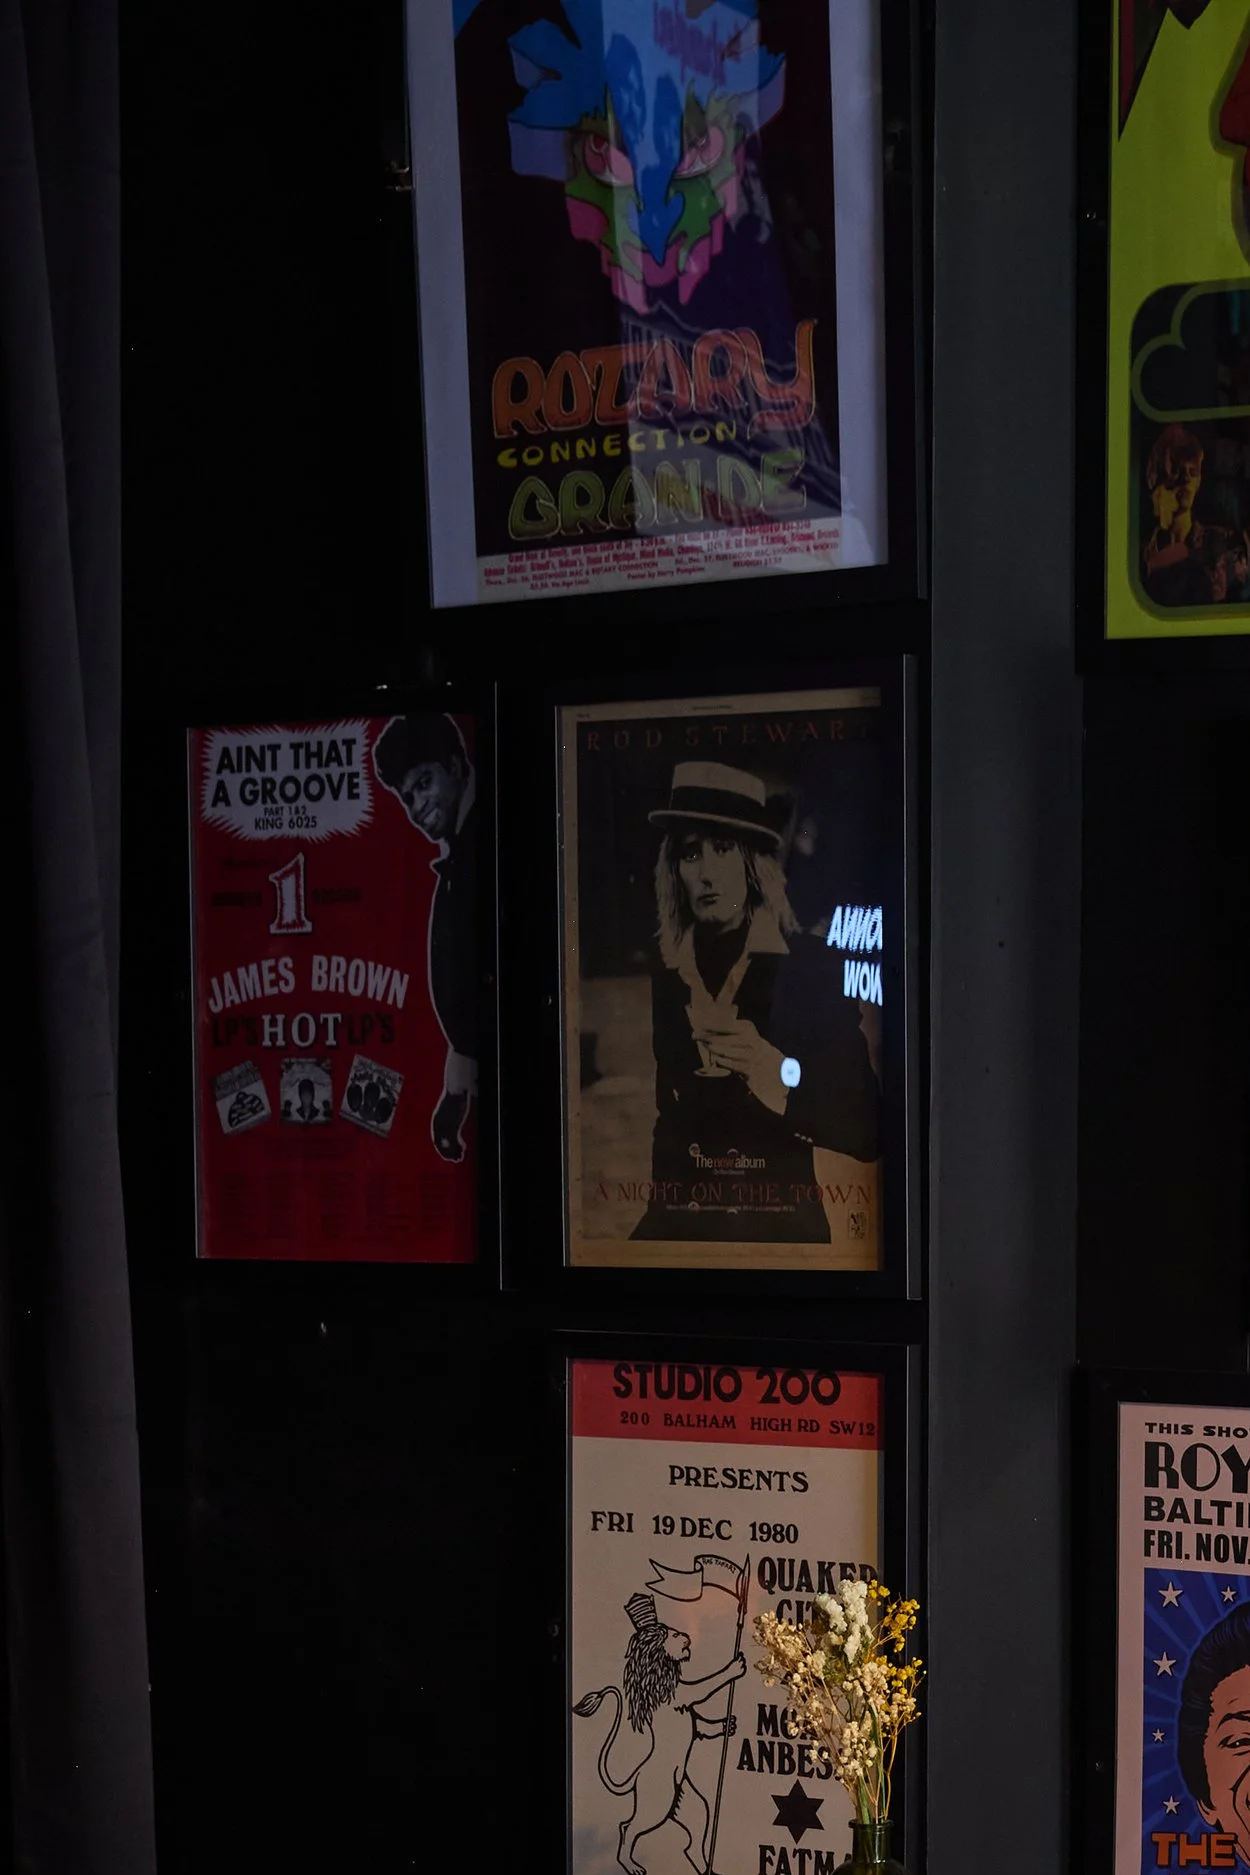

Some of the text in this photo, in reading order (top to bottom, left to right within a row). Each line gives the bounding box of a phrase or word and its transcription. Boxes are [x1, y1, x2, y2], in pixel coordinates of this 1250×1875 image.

[496, 420, 738, 468] CONNECTION
[215, 738, 357, 775] AINT THAT
[587, 728, 663, 751] ROD
[212, 771, 361, 808] A GROOVE
[254, 816, 318, 831] KING 6025
[264, 805, 285, 817] PART
[268, 851, 313, 935] 1
[208, 954, 410, 1014] JAMES BROWN
[261, 1012, 343, 1048] HOT
[694, 1155, 714, 1169] The
[734, 1153, 766, 1170] album
[594, 1181, 874, 1204] A NIGHT ON THE TOWN
[613, 1363, 841, 1406] STUDIO 200
[619, 1409, 876, 1437] 200 BALHAM HIGH RD SW12
[1145, 1422, 1194, 1436] THIS
[669, 1464, 809, 1493] PRESENTS
[590, 1510, 800, 1544] FRI 19 DEC 1980
[1144, 1530, 1191, 1561] FRI.
[737, 1739, 842, 1781] ANBES
[1150, 1832, 1238, 1868] THE
